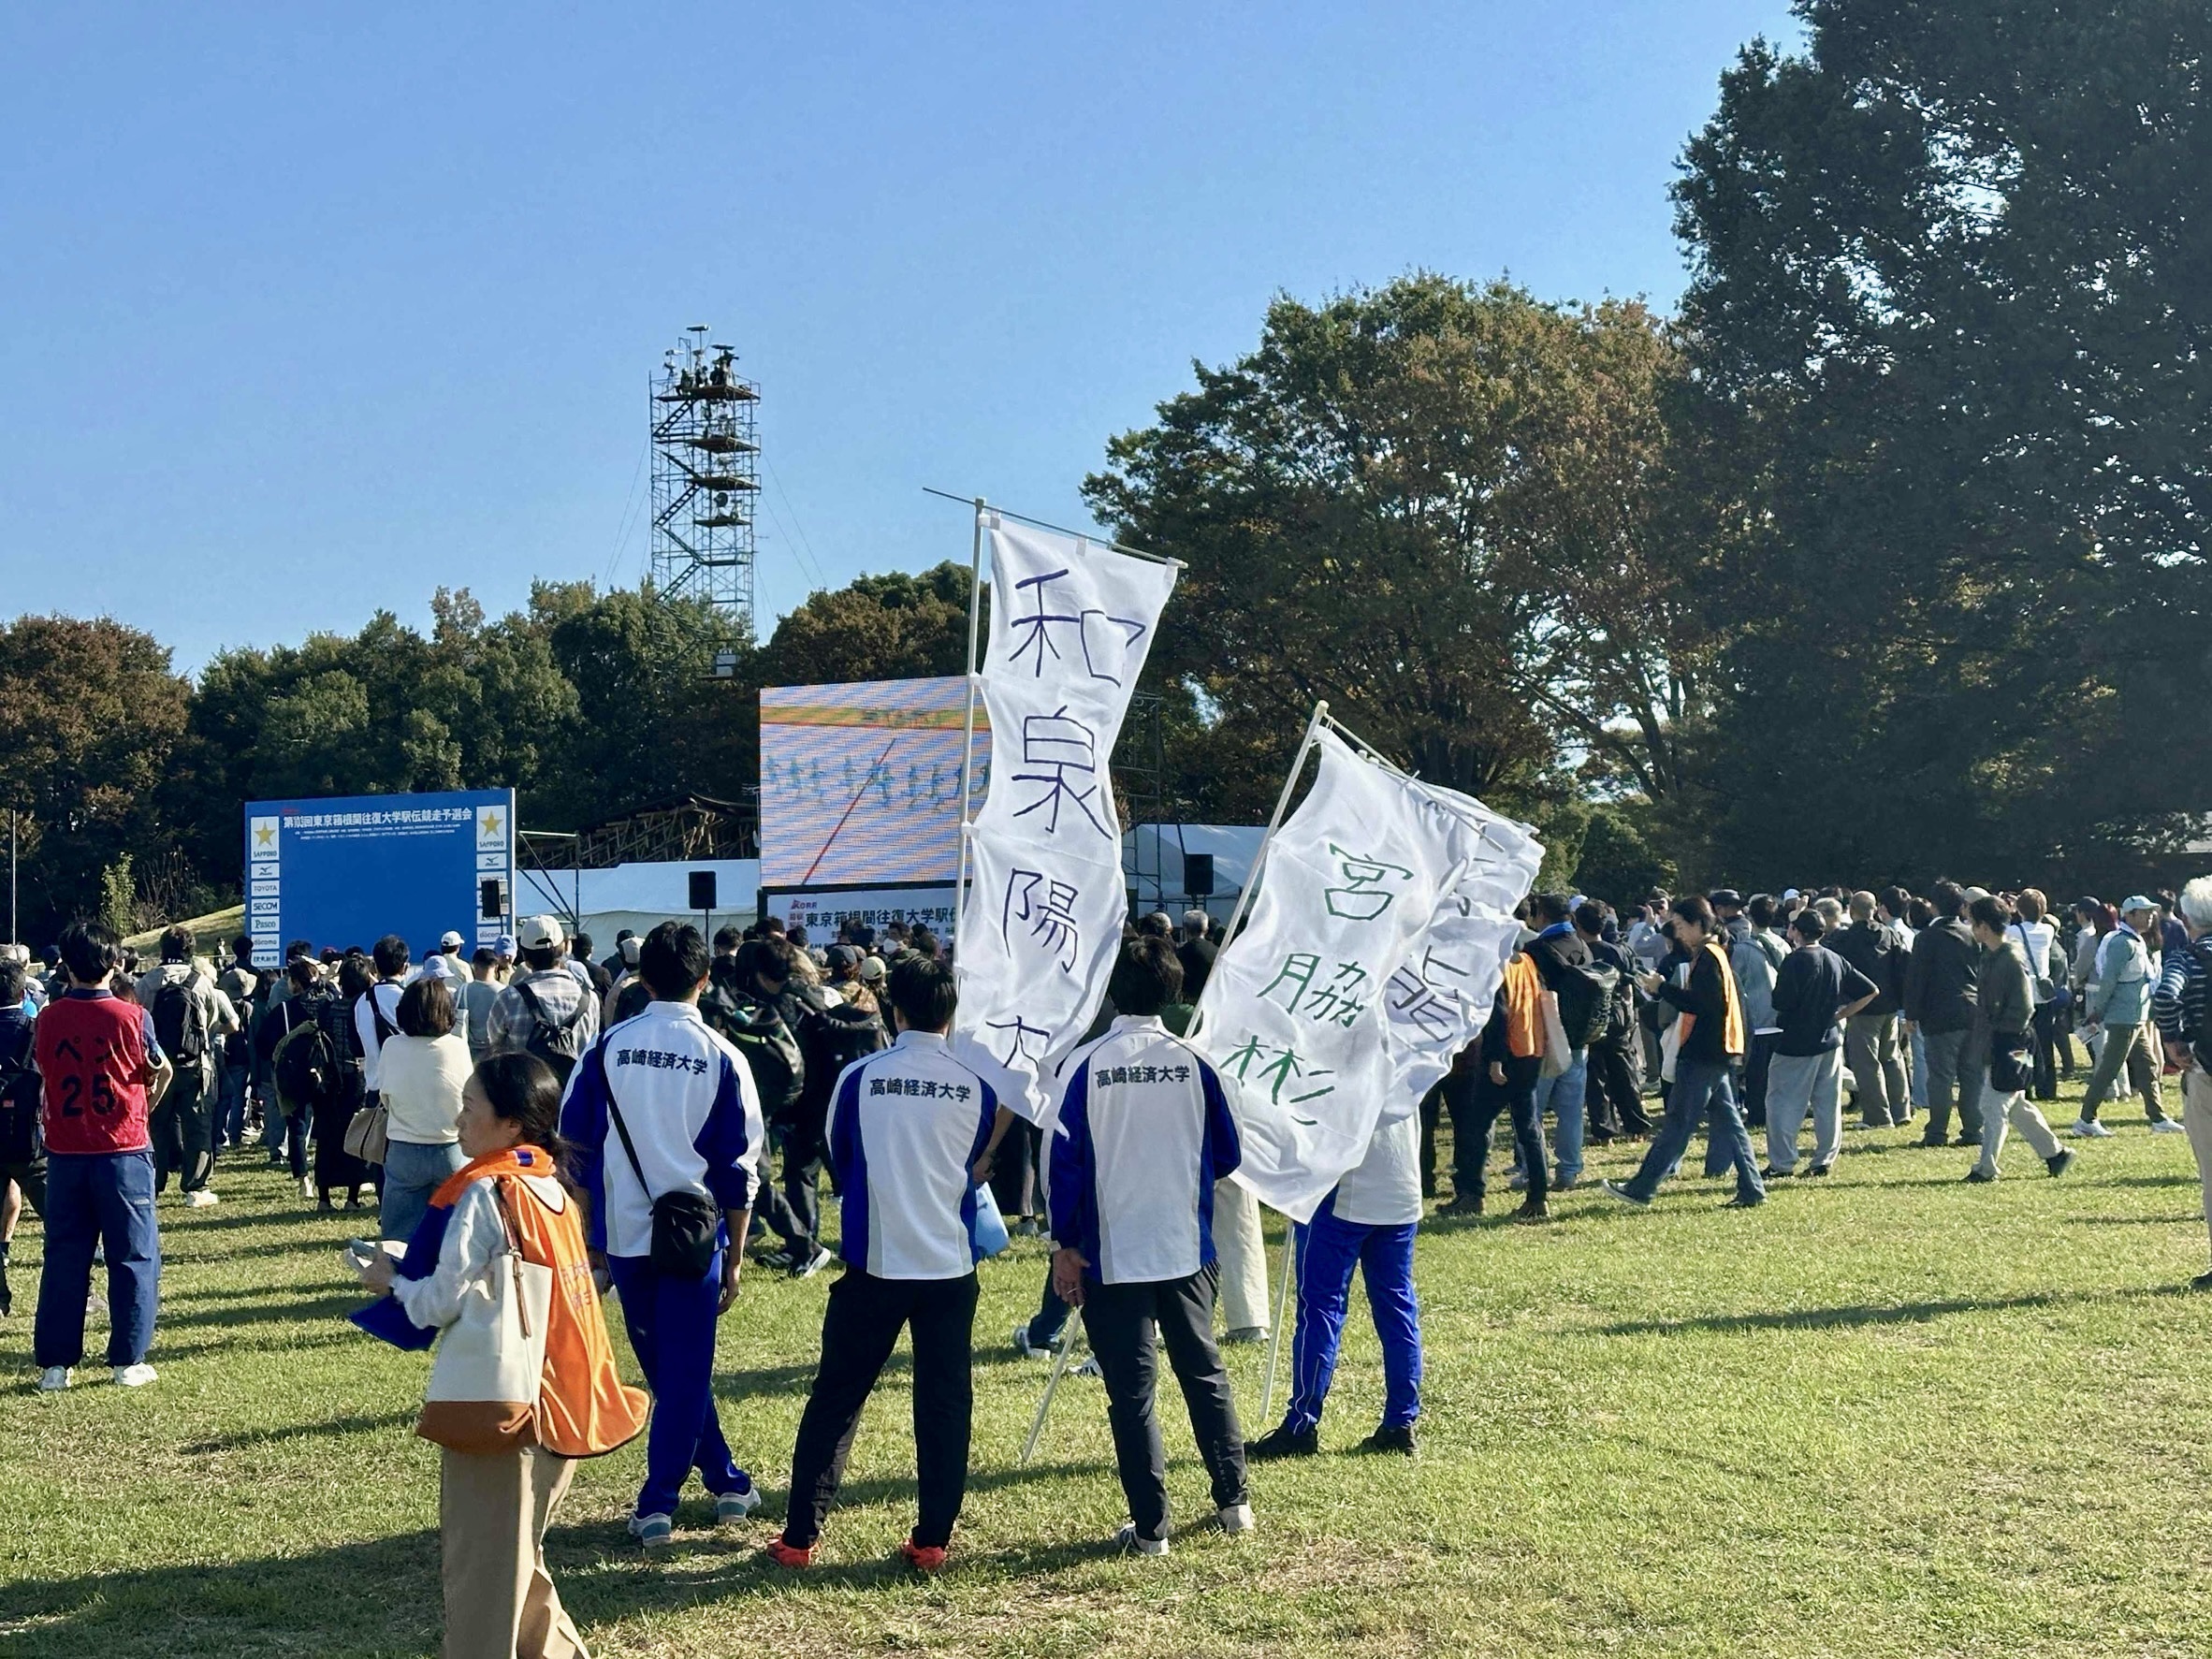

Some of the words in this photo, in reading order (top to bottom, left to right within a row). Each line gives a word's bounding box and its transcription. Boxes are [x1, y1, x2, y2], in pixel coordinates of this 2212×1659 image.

[254, 902, 278, 911] SECOM
[255, 920, 276, 929] Pasco
[617, 1048, 708, 1075] 高崎経済大学
[1095, 1065, 1190, 1088] 高崎経済大学
[61, 1073, 116, 1118] 25
[869, 1077, 971, 1102] 高崎経済大学
